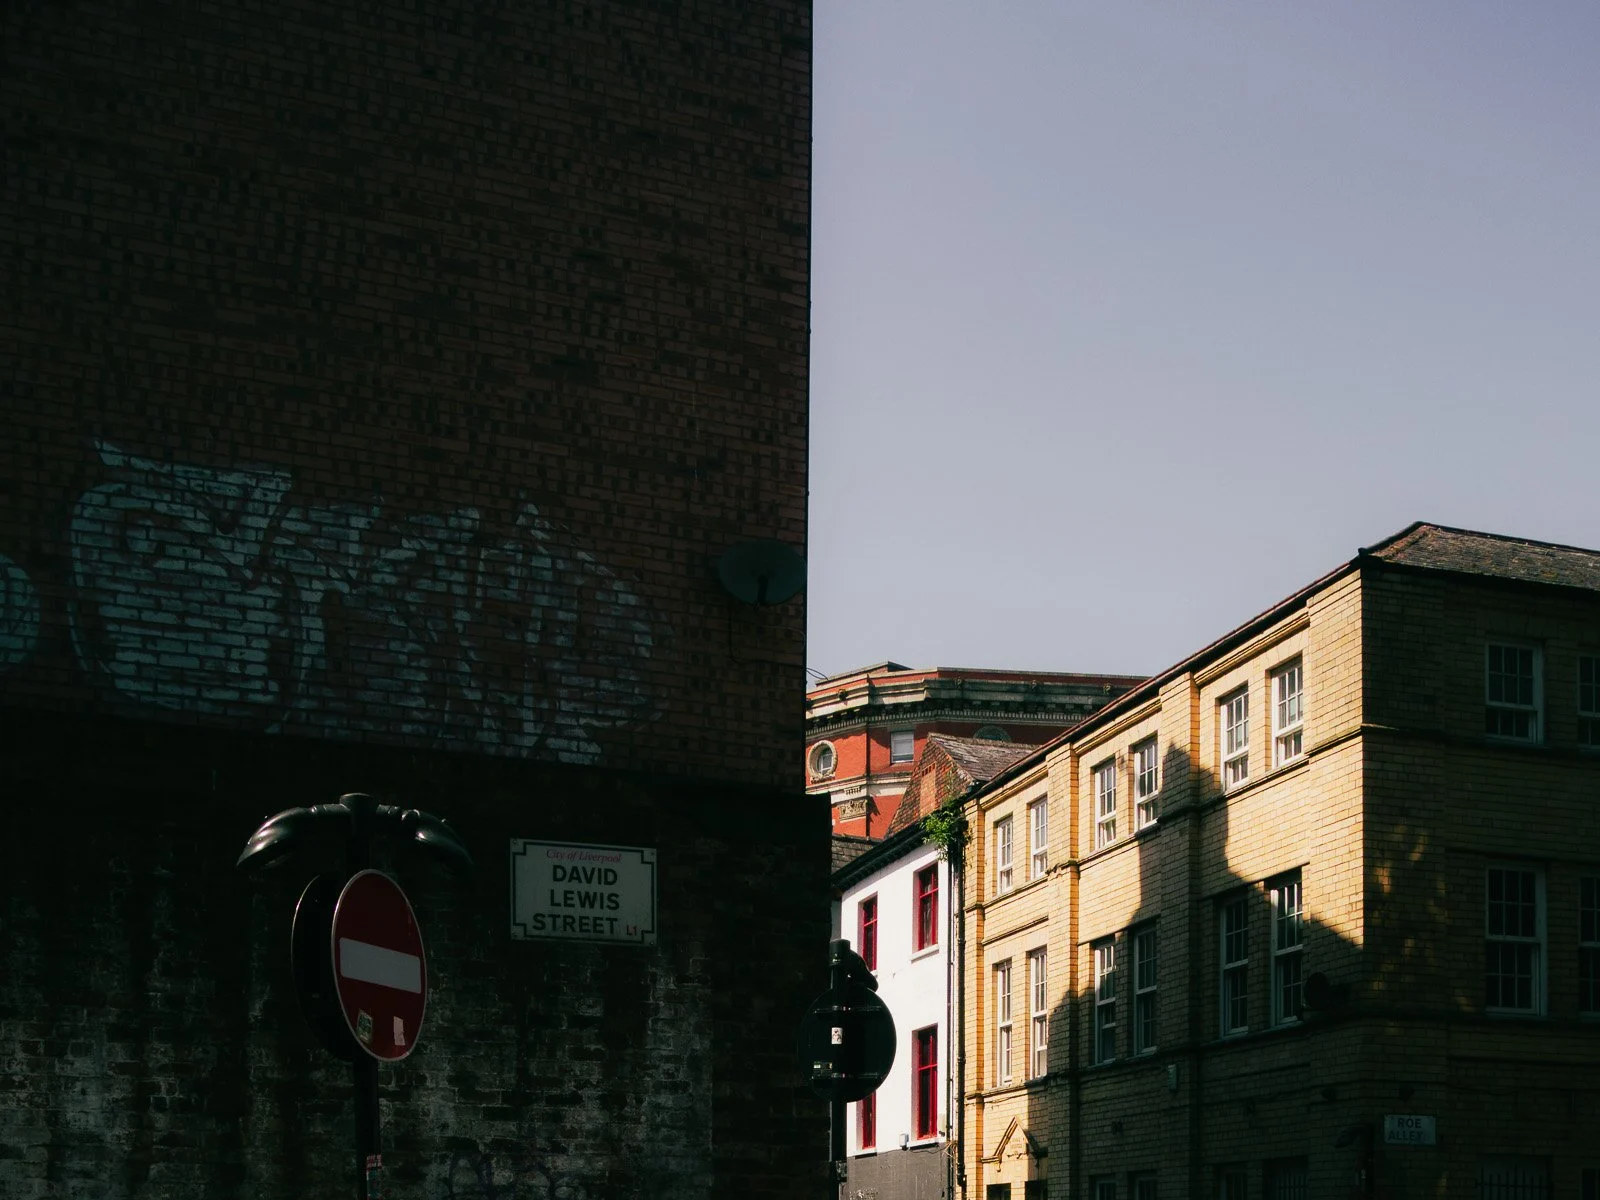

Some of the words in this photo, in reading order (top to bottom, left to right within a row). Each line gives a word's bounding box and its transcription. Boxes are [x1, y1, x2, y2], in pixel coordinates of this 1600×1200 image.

[546, 849, 565, 860] City
[566, 850, 578, 862] of
[579, 851, 622, 863] Liverpool
[553, 864, 618, 886] DAVID
[550, 889, 620, 911] LEWIS
[532, 913, 618, 935] STREET
[626, 925, 637, 936] L1
[1397, 1118, 1422, 1128] ROE
[1388, 1130, 1423, 1141] ALLEY
